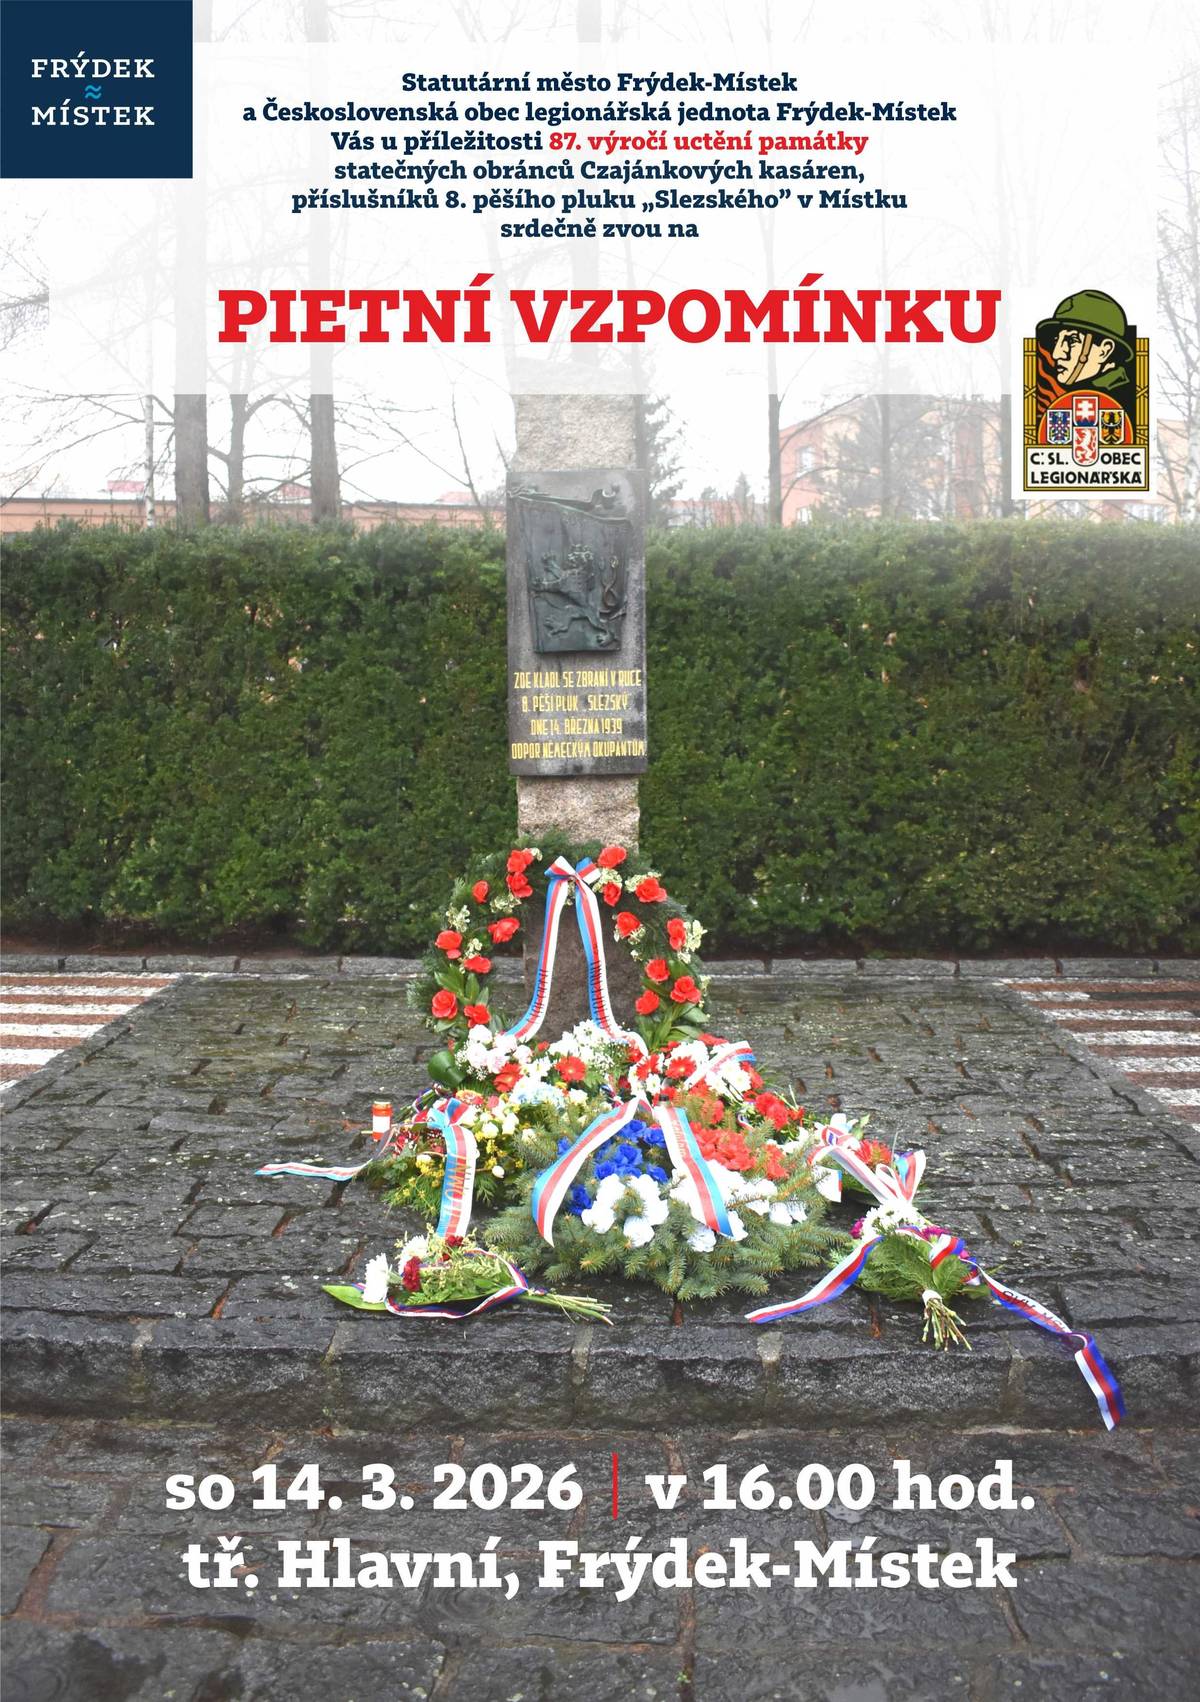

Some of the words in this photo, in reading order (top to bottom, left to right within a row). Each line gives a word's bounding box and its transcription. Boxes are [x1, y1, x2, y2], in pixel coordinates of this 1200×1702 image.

[514, 671, 531, 689] ZDE
[533, 671, 561, 689] KLADL
[563, 670, 575, 688] SE
[576, 668, 608, 688] ZBRANÍ
[610, 670, 617, 688] V
[618, 669, 642, 688] RUCE
[556, 695, 579, 712] PLUK
[530, 718, 548, 735] DNE
[564, 715, 600, 735] BŘEZNA
[601, 717, 623, 735] 1939
[511, 741, 541, 760] ODPOR
[542, 739, 591, 760] NĚMECKÝM
